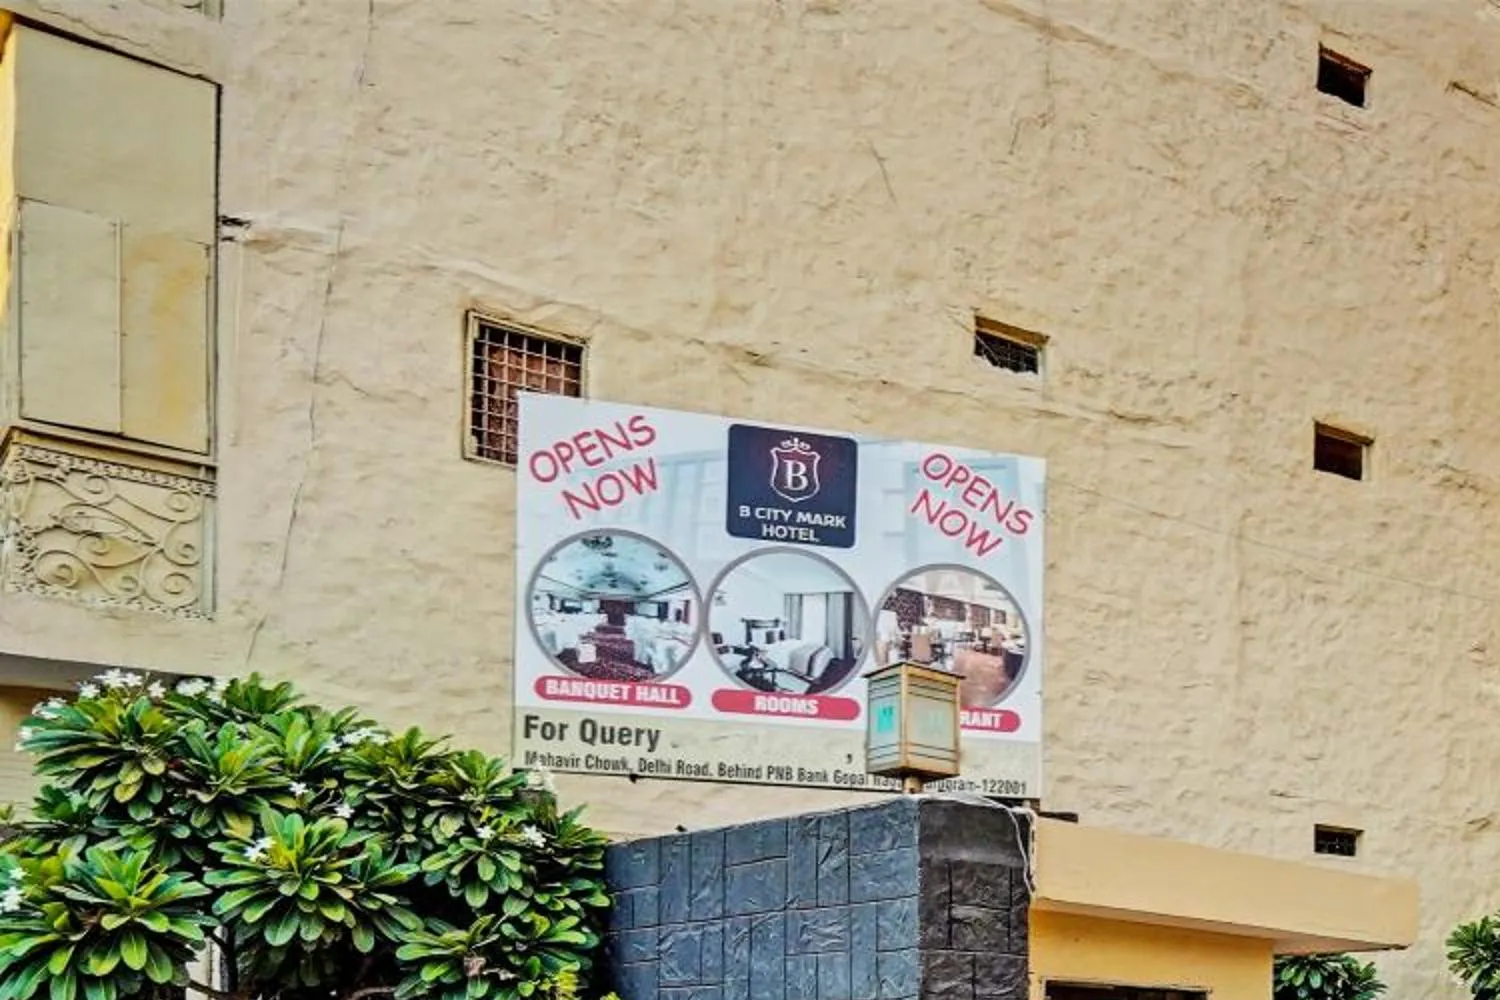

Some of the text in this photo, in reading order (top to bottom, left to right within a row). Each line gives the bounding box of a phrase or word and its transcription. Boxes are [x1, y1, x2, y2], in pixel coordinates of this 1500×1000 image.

[529, 415, 656, 483] OPENS
[561, 457, 657, 520] NOW
[783, 459, 809, 491] B
[923, 453, 1034, 535] OPENS
[739, 505, 847, 529] B CITY MARK
[761, 523, 820, 542] HOTEL
[911, 489, 1003, 557] NOW
[546, 679, 681, 704] BANQUET HALL
[754, 695, 819, 715] ROOMS
[524, 715, 662, 752] For Query
[524, 750, 580, 768] Mahavir
[638, 757, 672, 774] Delhi
[718, 761, 762, 779] Behind
[767, 765, 793, 781] PNB
[798, 767, 829, 782] Bank
[833, 769, 868, 786] Gopal
